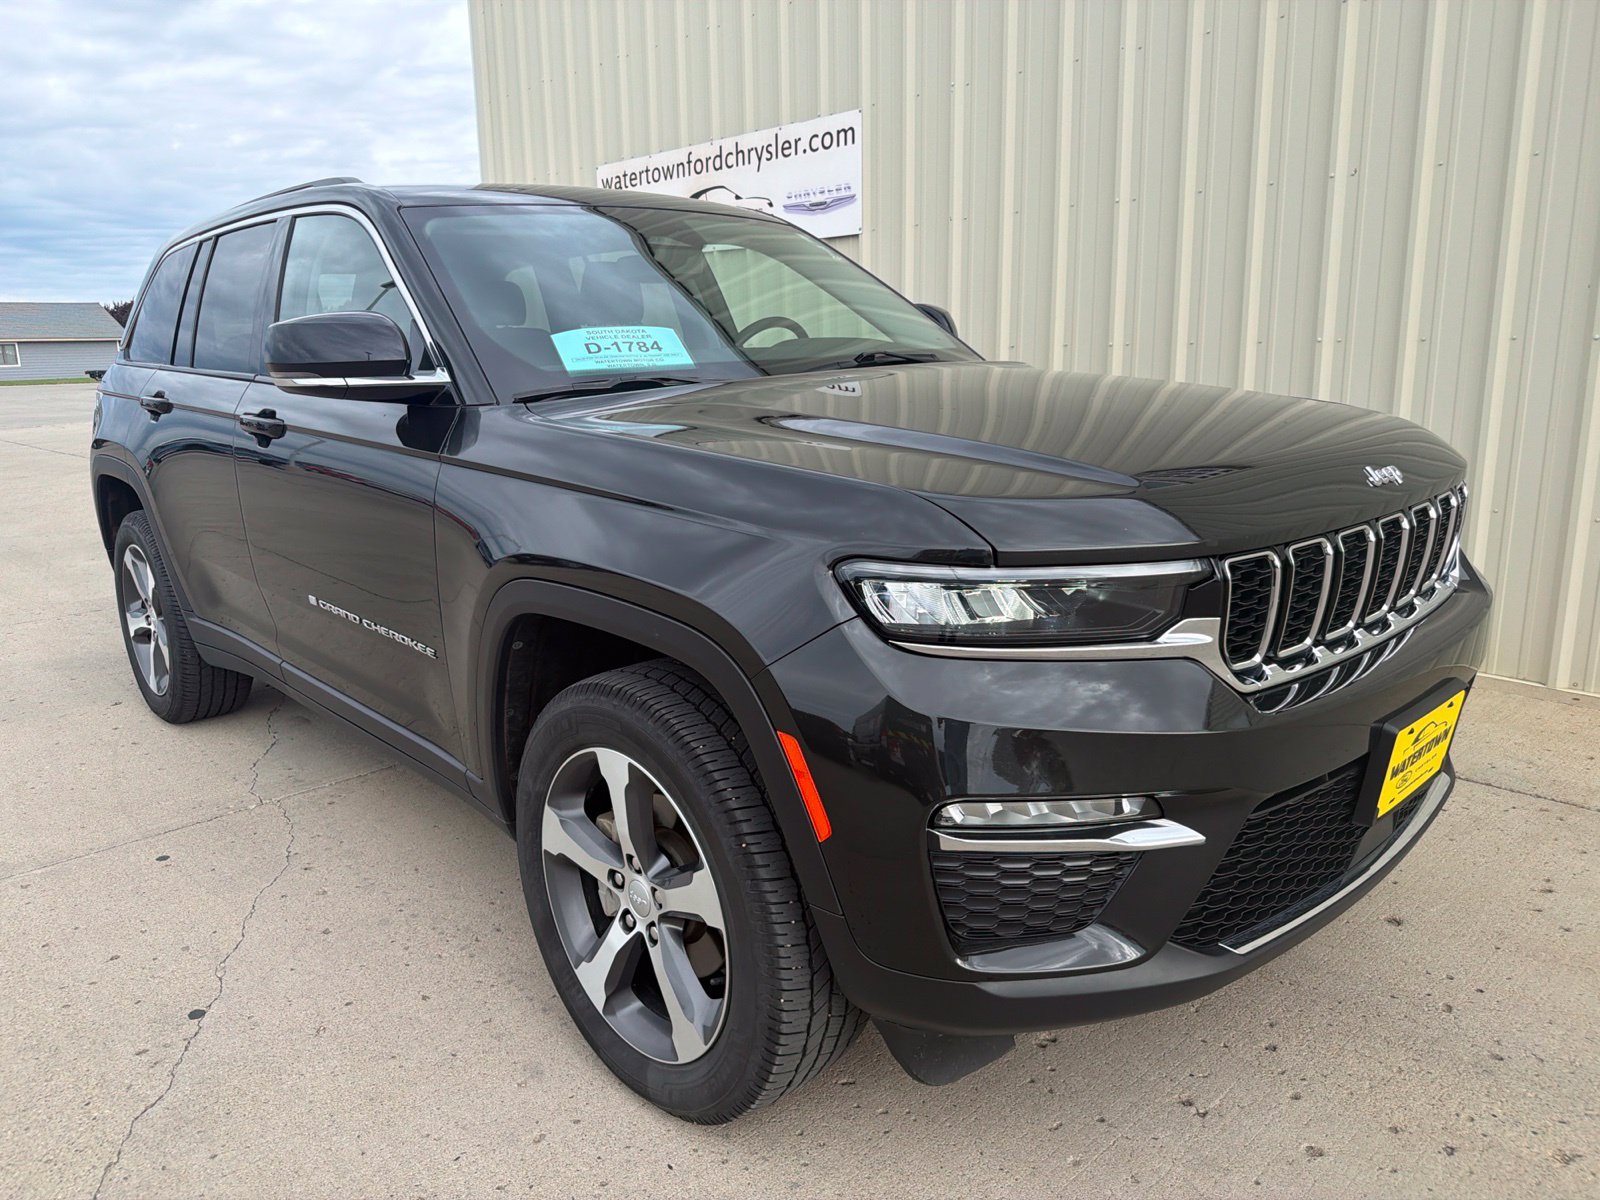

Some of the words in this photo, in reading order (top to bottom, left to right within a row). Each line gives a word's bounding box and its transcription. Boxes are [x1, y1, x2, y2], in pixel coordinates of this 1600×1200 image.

[601, 126, 856, 190] watertownfordchrysler.com
[584, 340, 663, 354] D-1784
[1364, 465, 1403, 487] Jeep
[318, 600, 359, 625] GRAND
[362, 619, 438, 660] CHEROKEE
[1389, 724, 1452, 782] WATERTOWN
